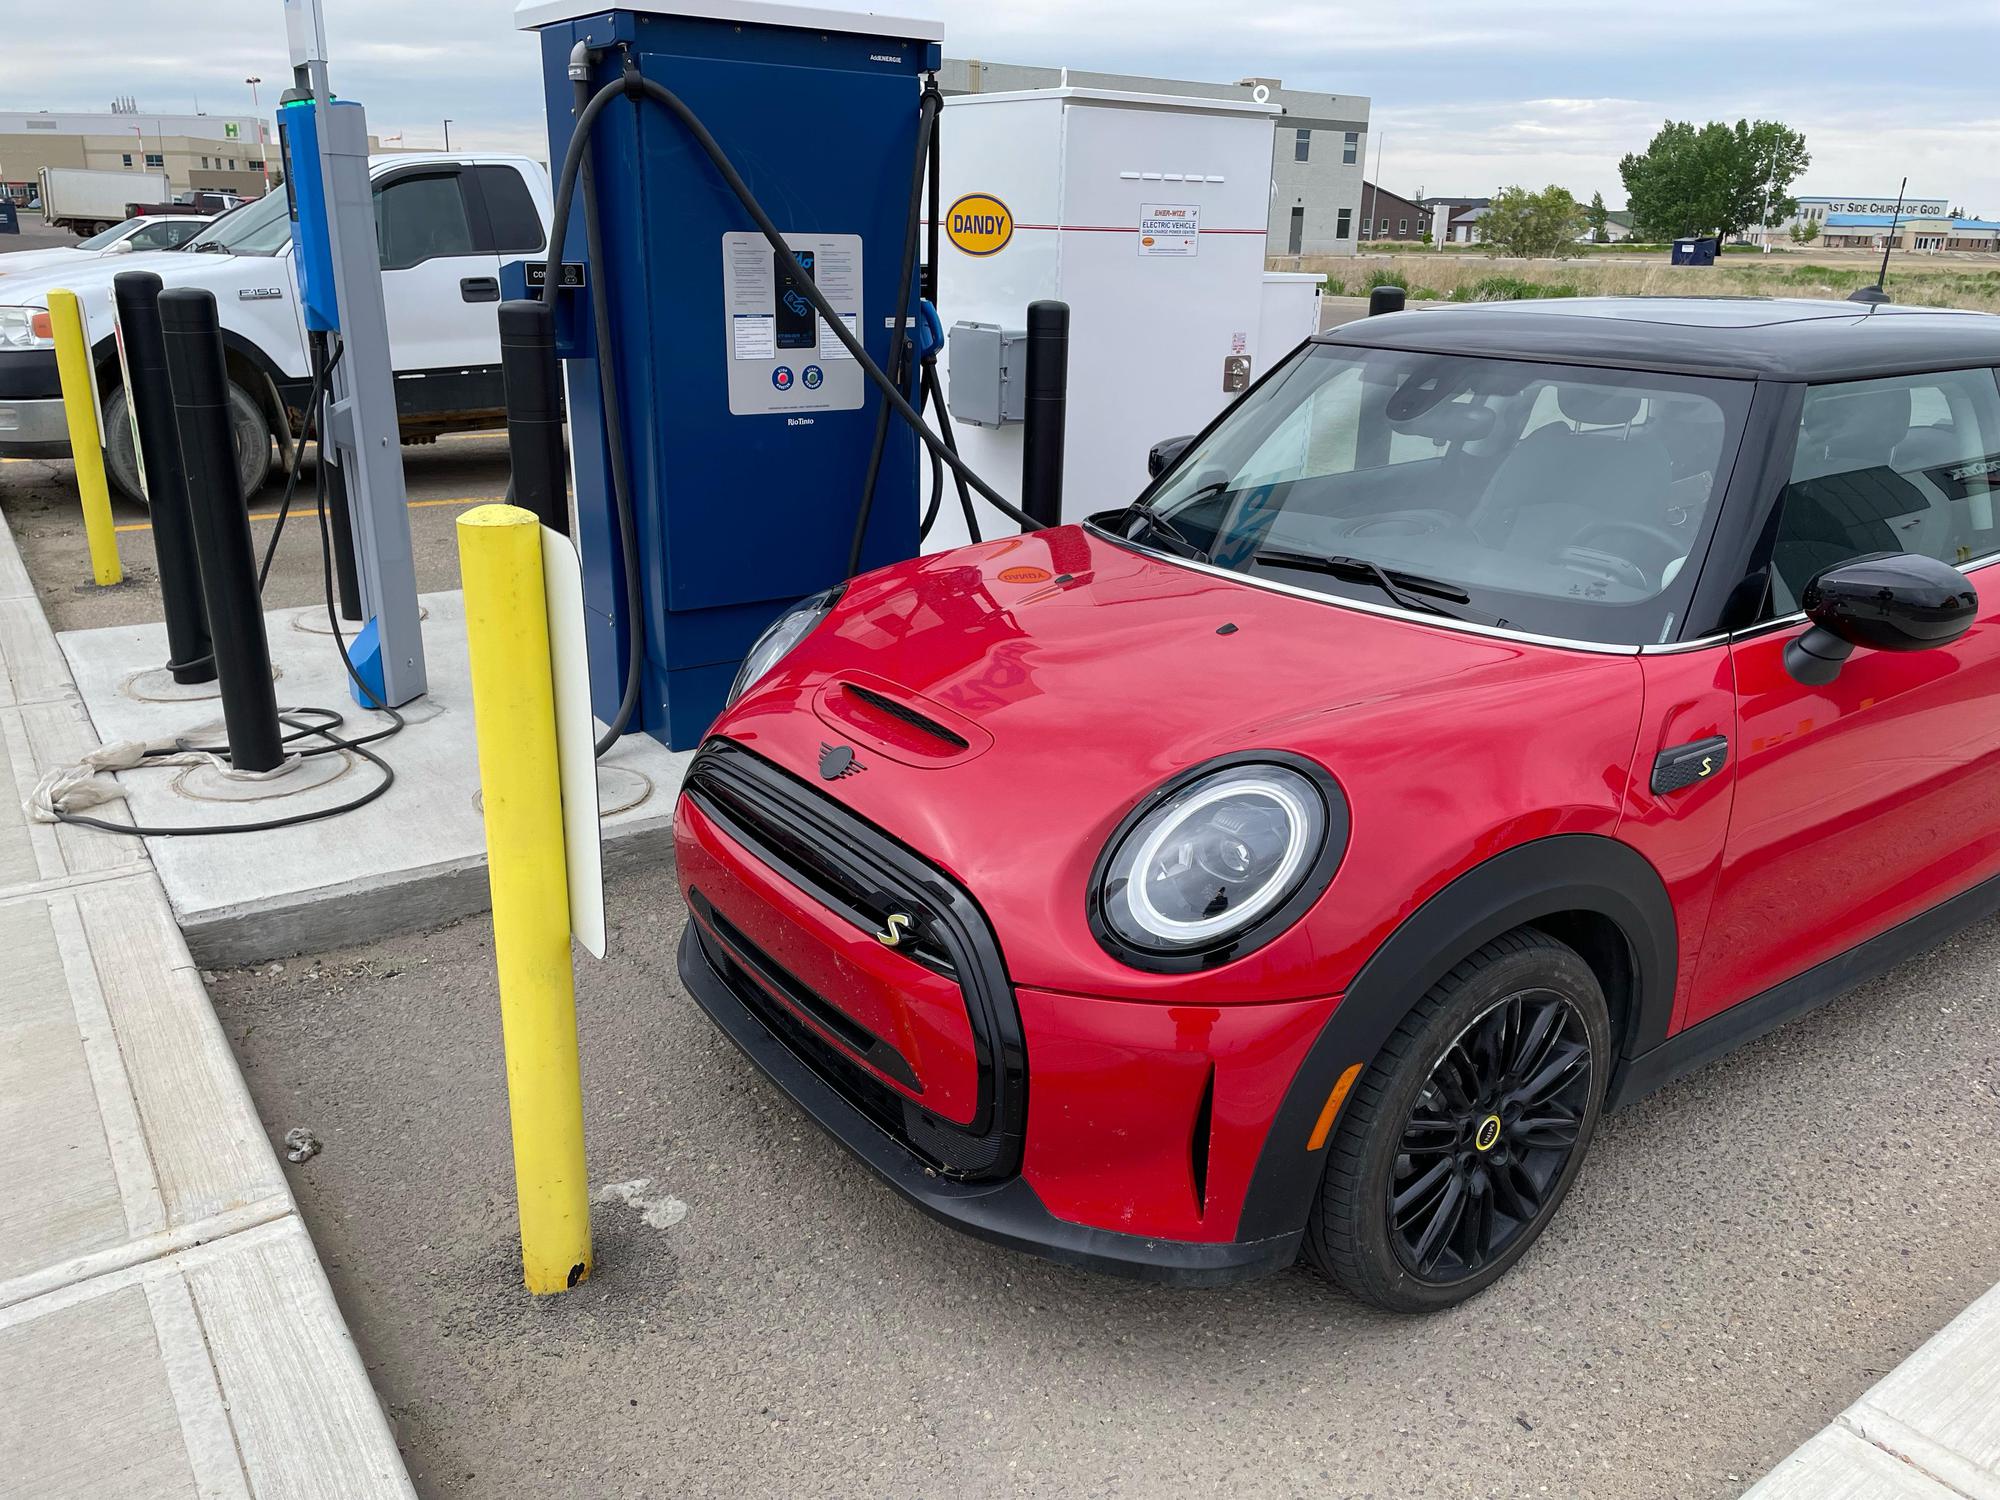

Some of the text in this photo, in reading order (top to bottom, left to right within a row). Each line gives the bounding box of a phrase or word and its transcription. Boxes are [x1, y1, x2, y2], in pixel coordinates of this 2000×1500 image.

[1828, 202, 1940, 215] AST SIDE CHURCH OF GOD
[954, 214, 1005, 235] DANDY
[1483, 1122, 1495, 1144] MINI
